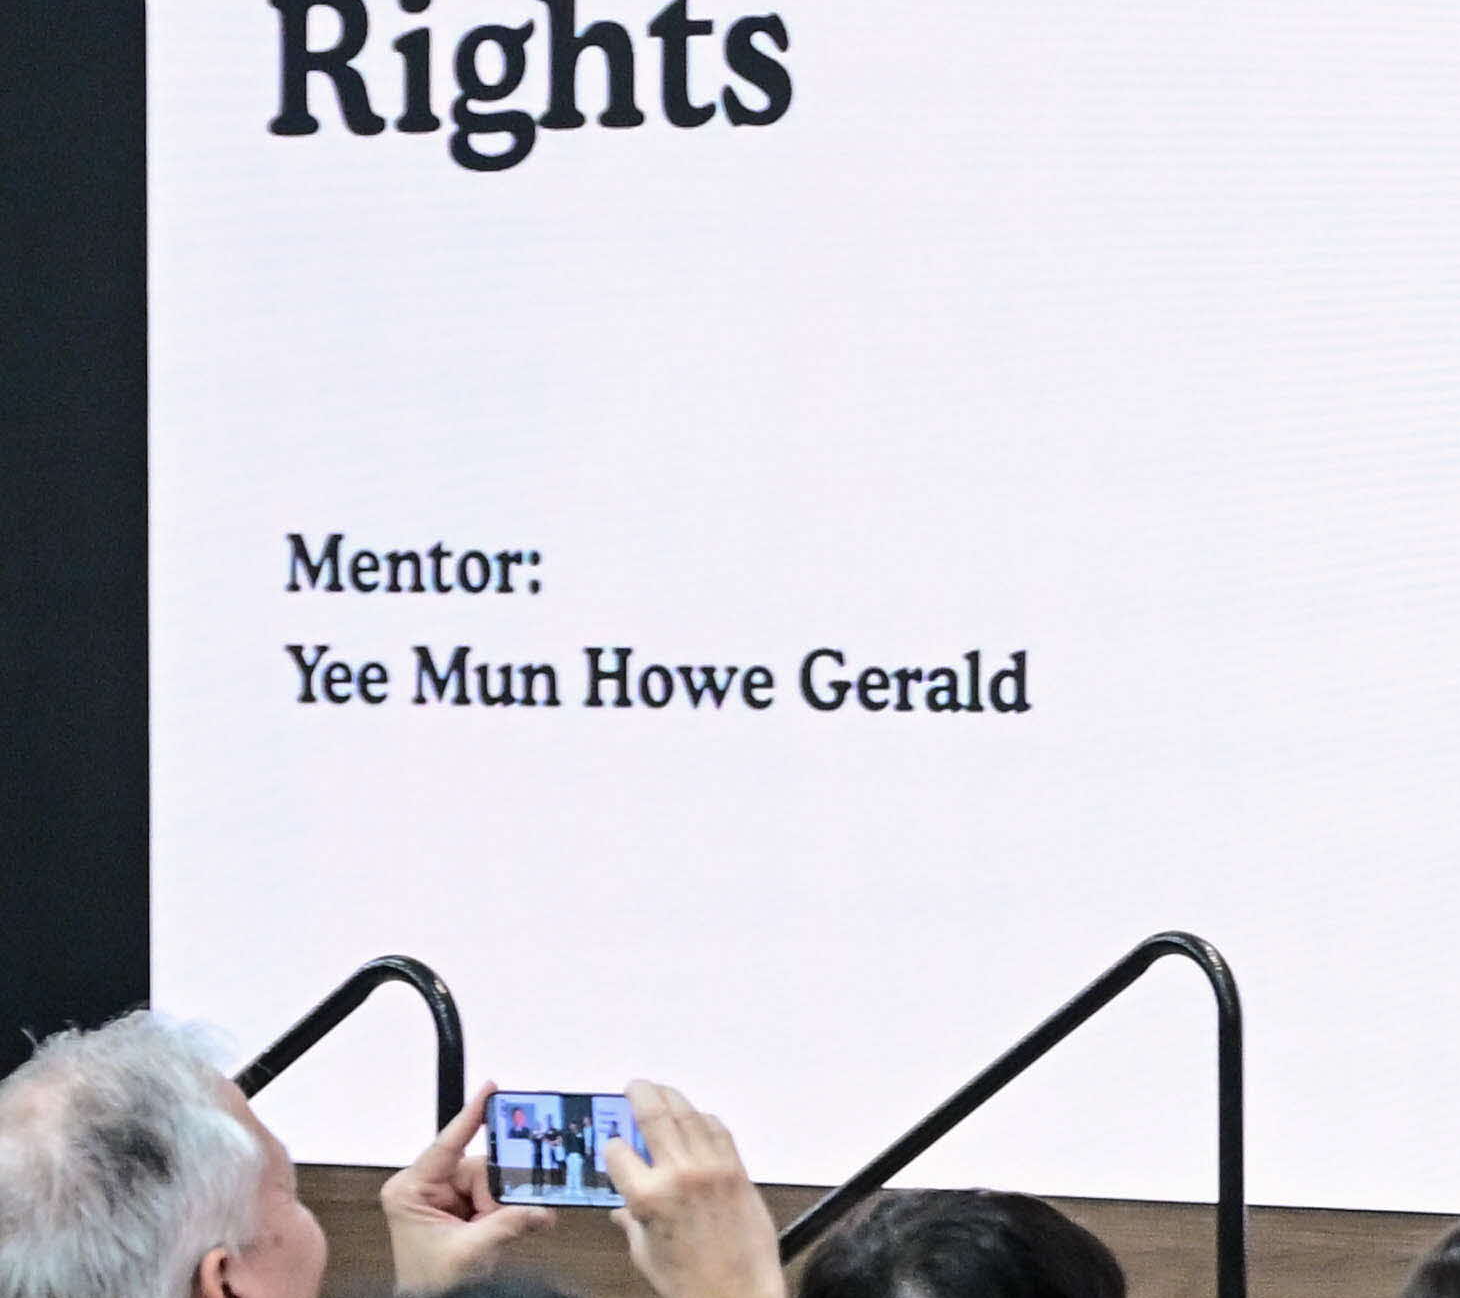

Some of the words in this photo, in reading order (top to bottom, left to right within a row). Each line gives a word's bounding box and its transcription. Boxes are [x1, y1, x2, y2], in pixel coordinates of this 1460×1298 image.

[285, 532, 542, 596] Mentor:
[284, 643, 390, 706] Yee
[411, 644, 562, 708] Mun
[583, 646, 776, 711] Howe
[798, 646, 1033, 715] Gerald
